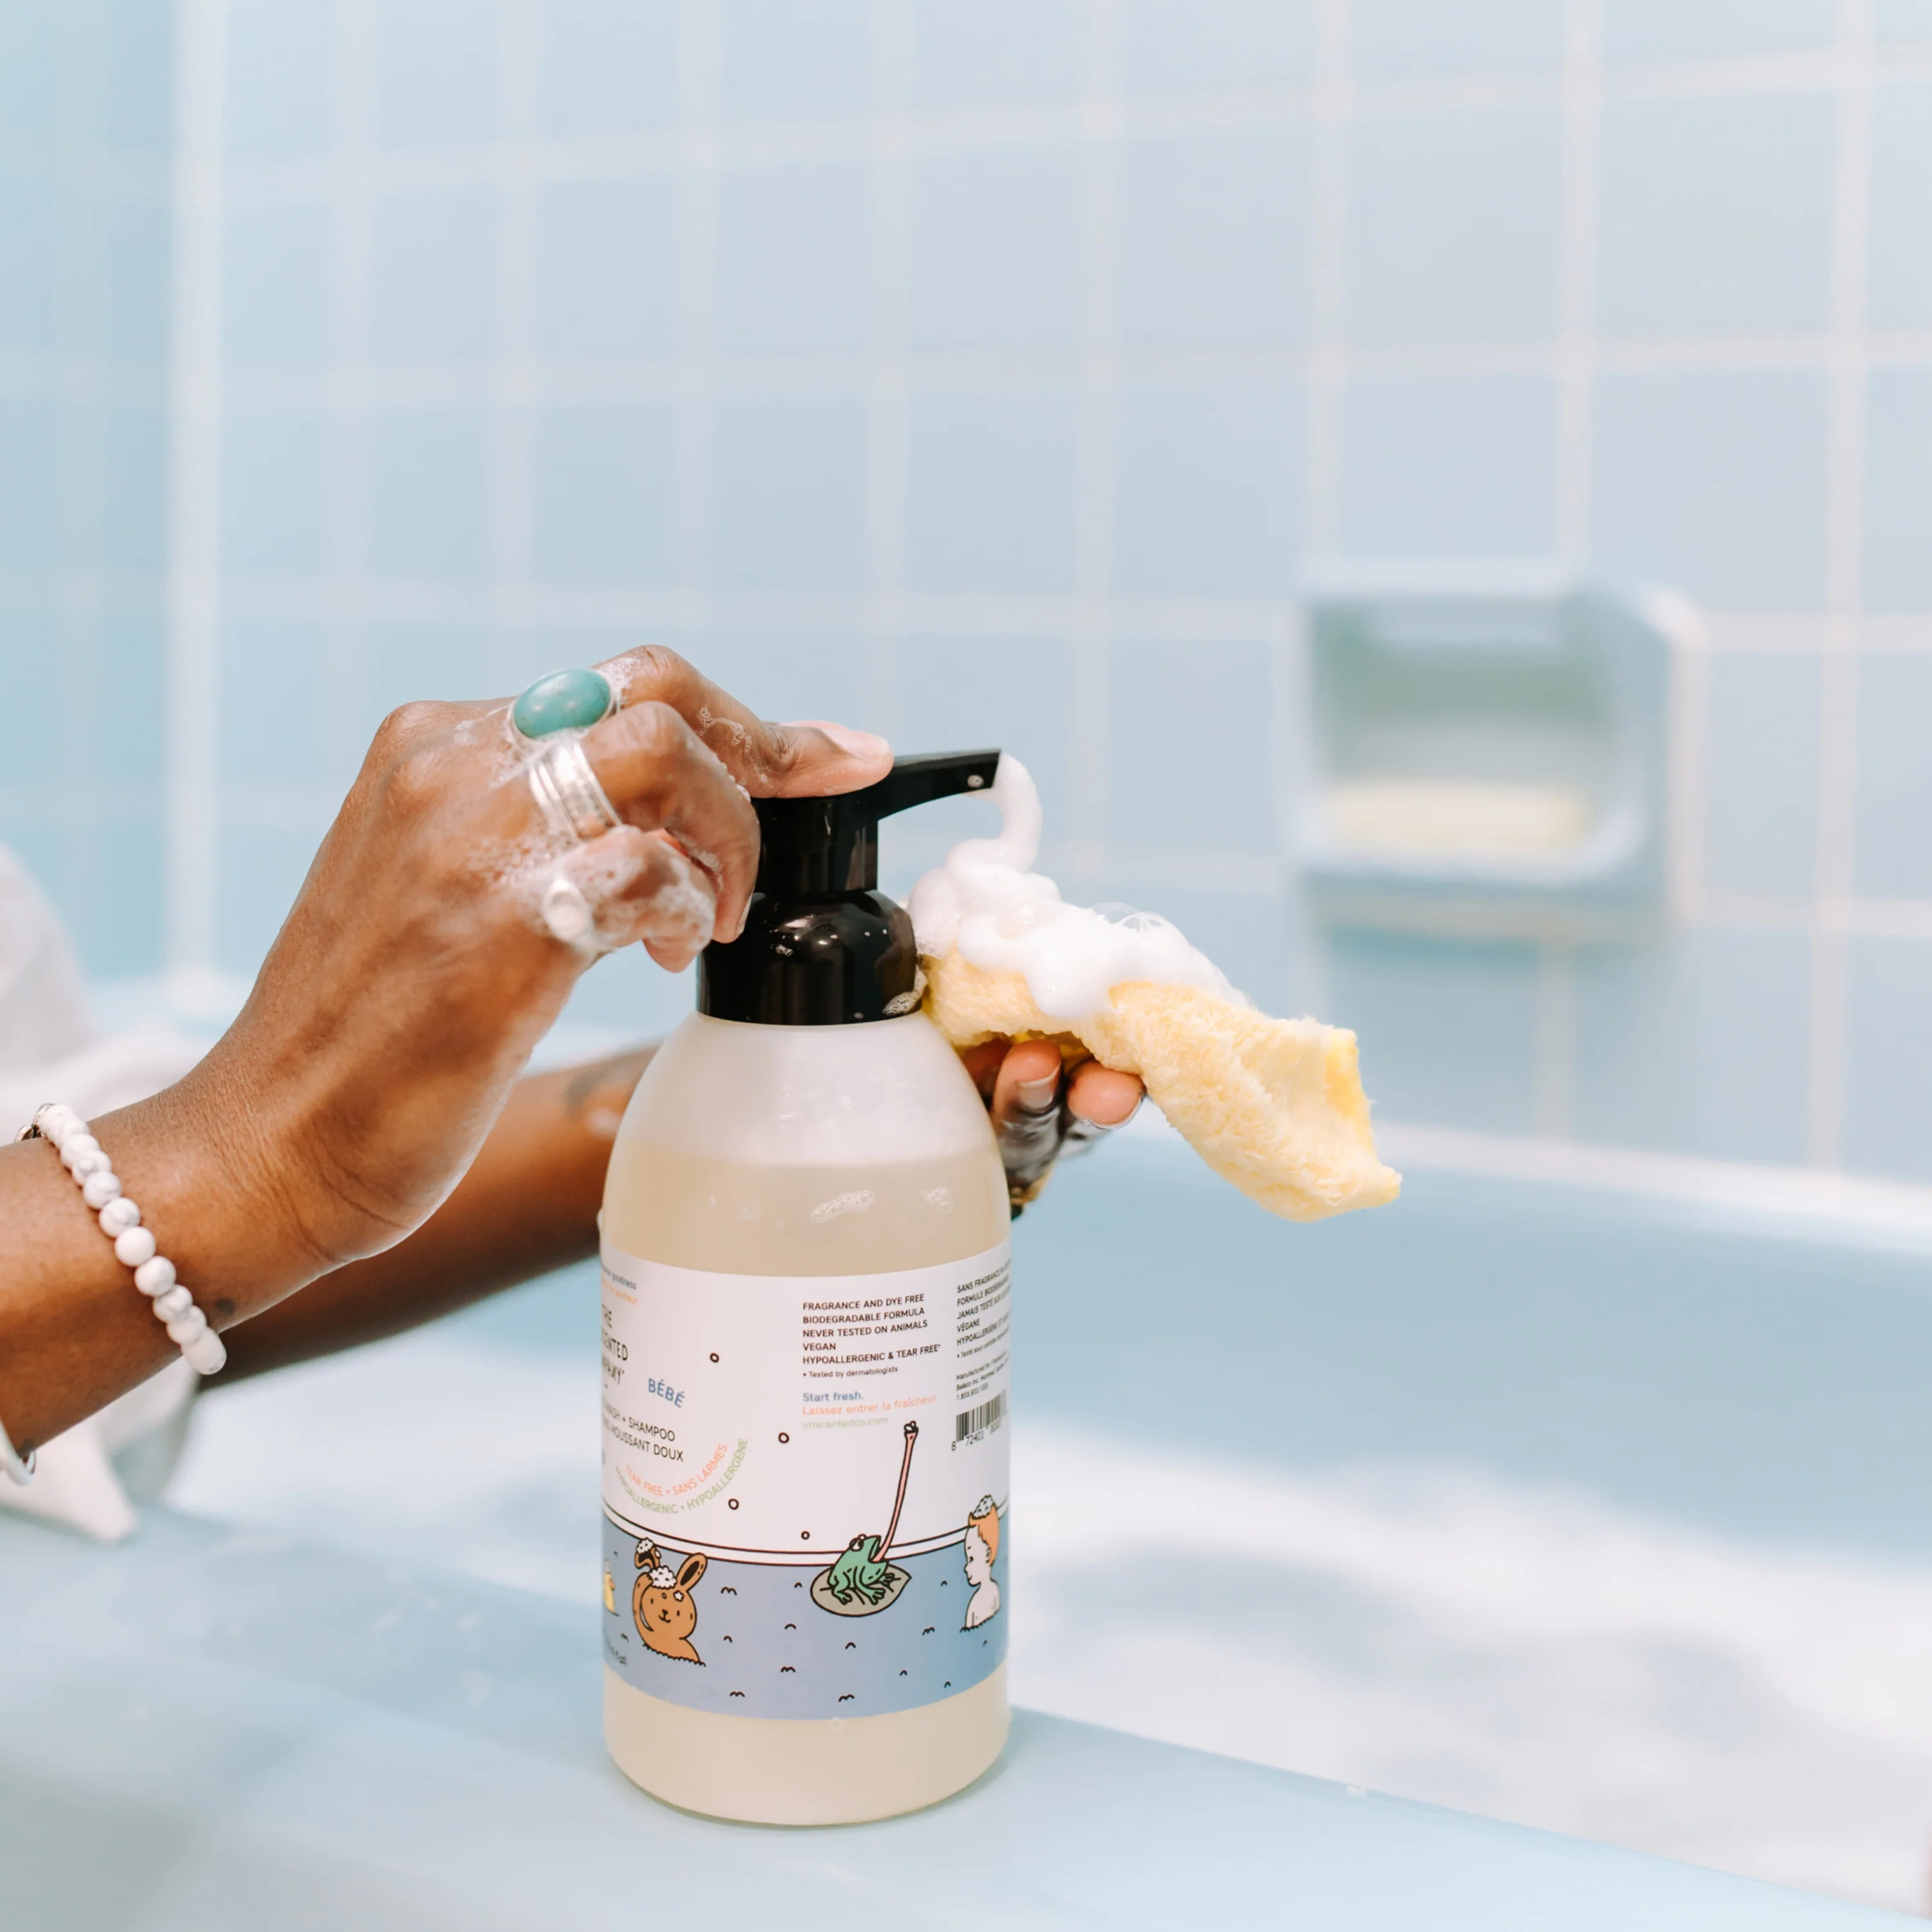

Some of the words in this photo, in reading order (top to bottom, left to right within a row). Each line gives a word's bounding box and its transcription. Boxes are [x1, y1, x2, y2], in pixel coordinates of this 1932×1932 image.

[957, 1282, 973, 1293] SANS
[803, 1301, 860, 1311] FRAGRANCE
[864, 1299, 883, 1308] AND
[886, 1297, 902, 1306] DYE
[905, 1294, 924, 1303] FREE
[957, 1291, 983, 1306] FORMULE
[803, 1312, 881, 1323] BIODEGRADABLE
[884, 1307, 925, 1320] FORMULA
[957, 1306, 979, 1319] JAMAIS
[837, 1327, 871, 1336] TESTED
[891, 1320, 928, 1332] ANIMALS
[957, 1318, 980, 1332] VÉGANE
[803, 1352, 886, 1364] HYPOALLERGENIC
[896, 1348, 918, 1358] TEAR
[846, 1367, 898, 1376] dermatologists
[648, 1378, 685, 1408] BÉBÉ
[803, 1392, 829, 1402] Start
[833, 1391, 864, 1401] fresh.
[802, 1406, 843, 1415] Laissez
[846, 1404, 878, 1413] entrer
[882, 1402, 891, 1411] la
[629, 1417, 675, 1441] SHAMPOO
[654, 1444, 683, 1462] DOUX
[951, 1441, 956, 1451] 8
[644, 1481, 663, 1496] FREE
[672, 1479, 697, 1496] SANS
[697, 1444, 728, 1483] LARMES
[616, 1465, 678, 1514] HYPOALLERGENIC
